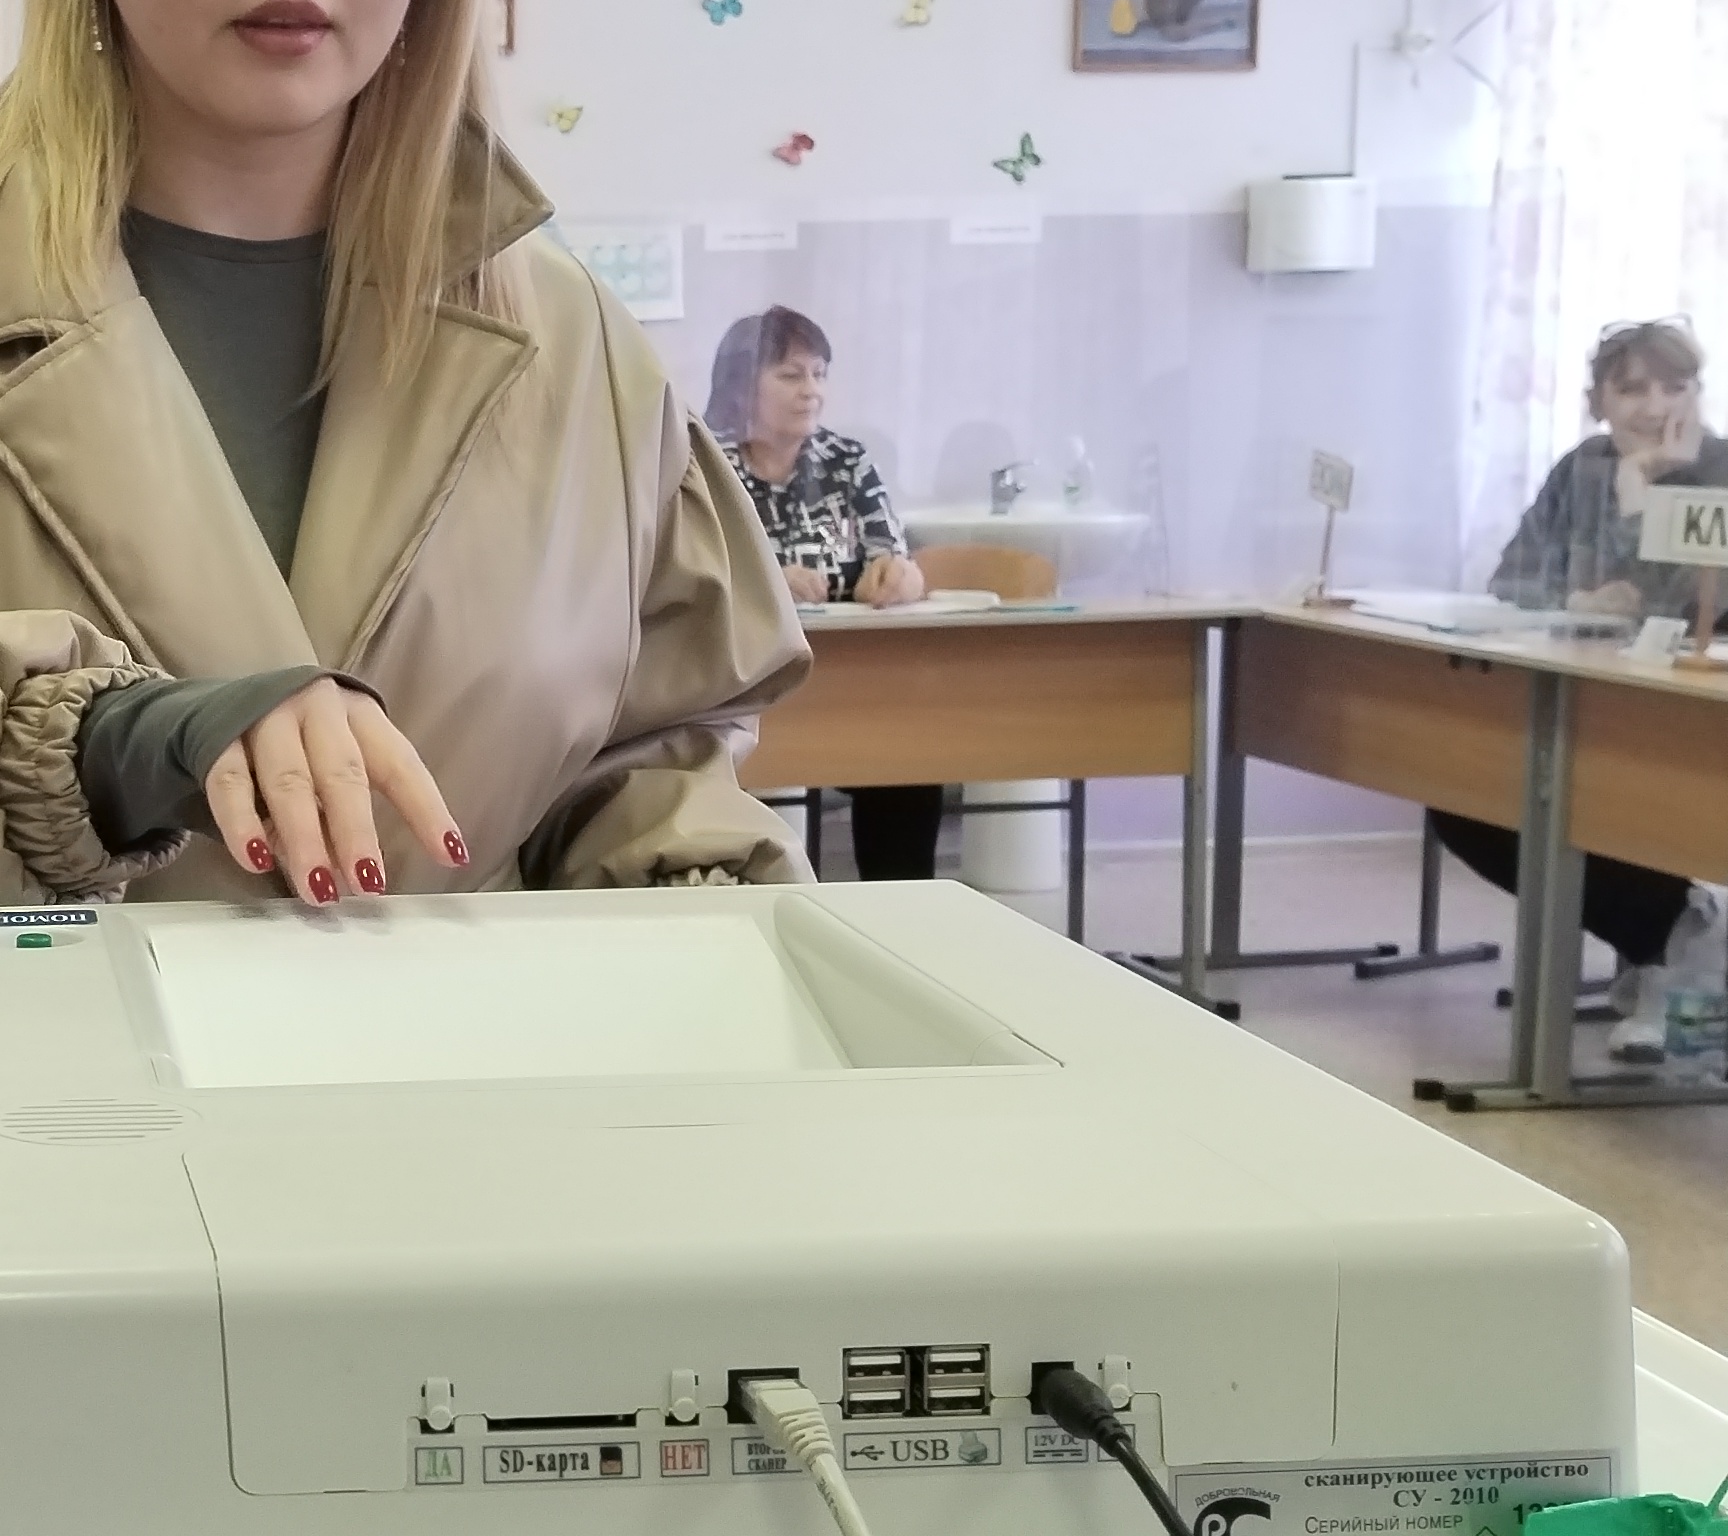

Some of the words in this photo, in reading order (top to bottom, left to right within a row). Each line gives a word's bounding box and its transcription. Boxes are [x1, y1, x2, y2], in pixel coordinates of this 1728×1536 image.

[889, 1438, 950, 1462] USB
[1034, 1433, 1058, 1447] 12V
[425, 1449, 453, 1479] ДА
[499, 1449, 590, 1478] SD-карта
[662, 1444, 707, 1471] НЕТ
[1304, 1468, 1458, 1490] сканирующее
[1466, 1462, 1589, 1484] устройство
[1194, 1486, 1281, 1508] ДОБРОВОЛЬНАЯ
[1392, 1489, 1427, 1508] СУ
[1449, 1486, 1500, 1506] 2010
[1405, 1514, 1464, 1531] НОМЕР
